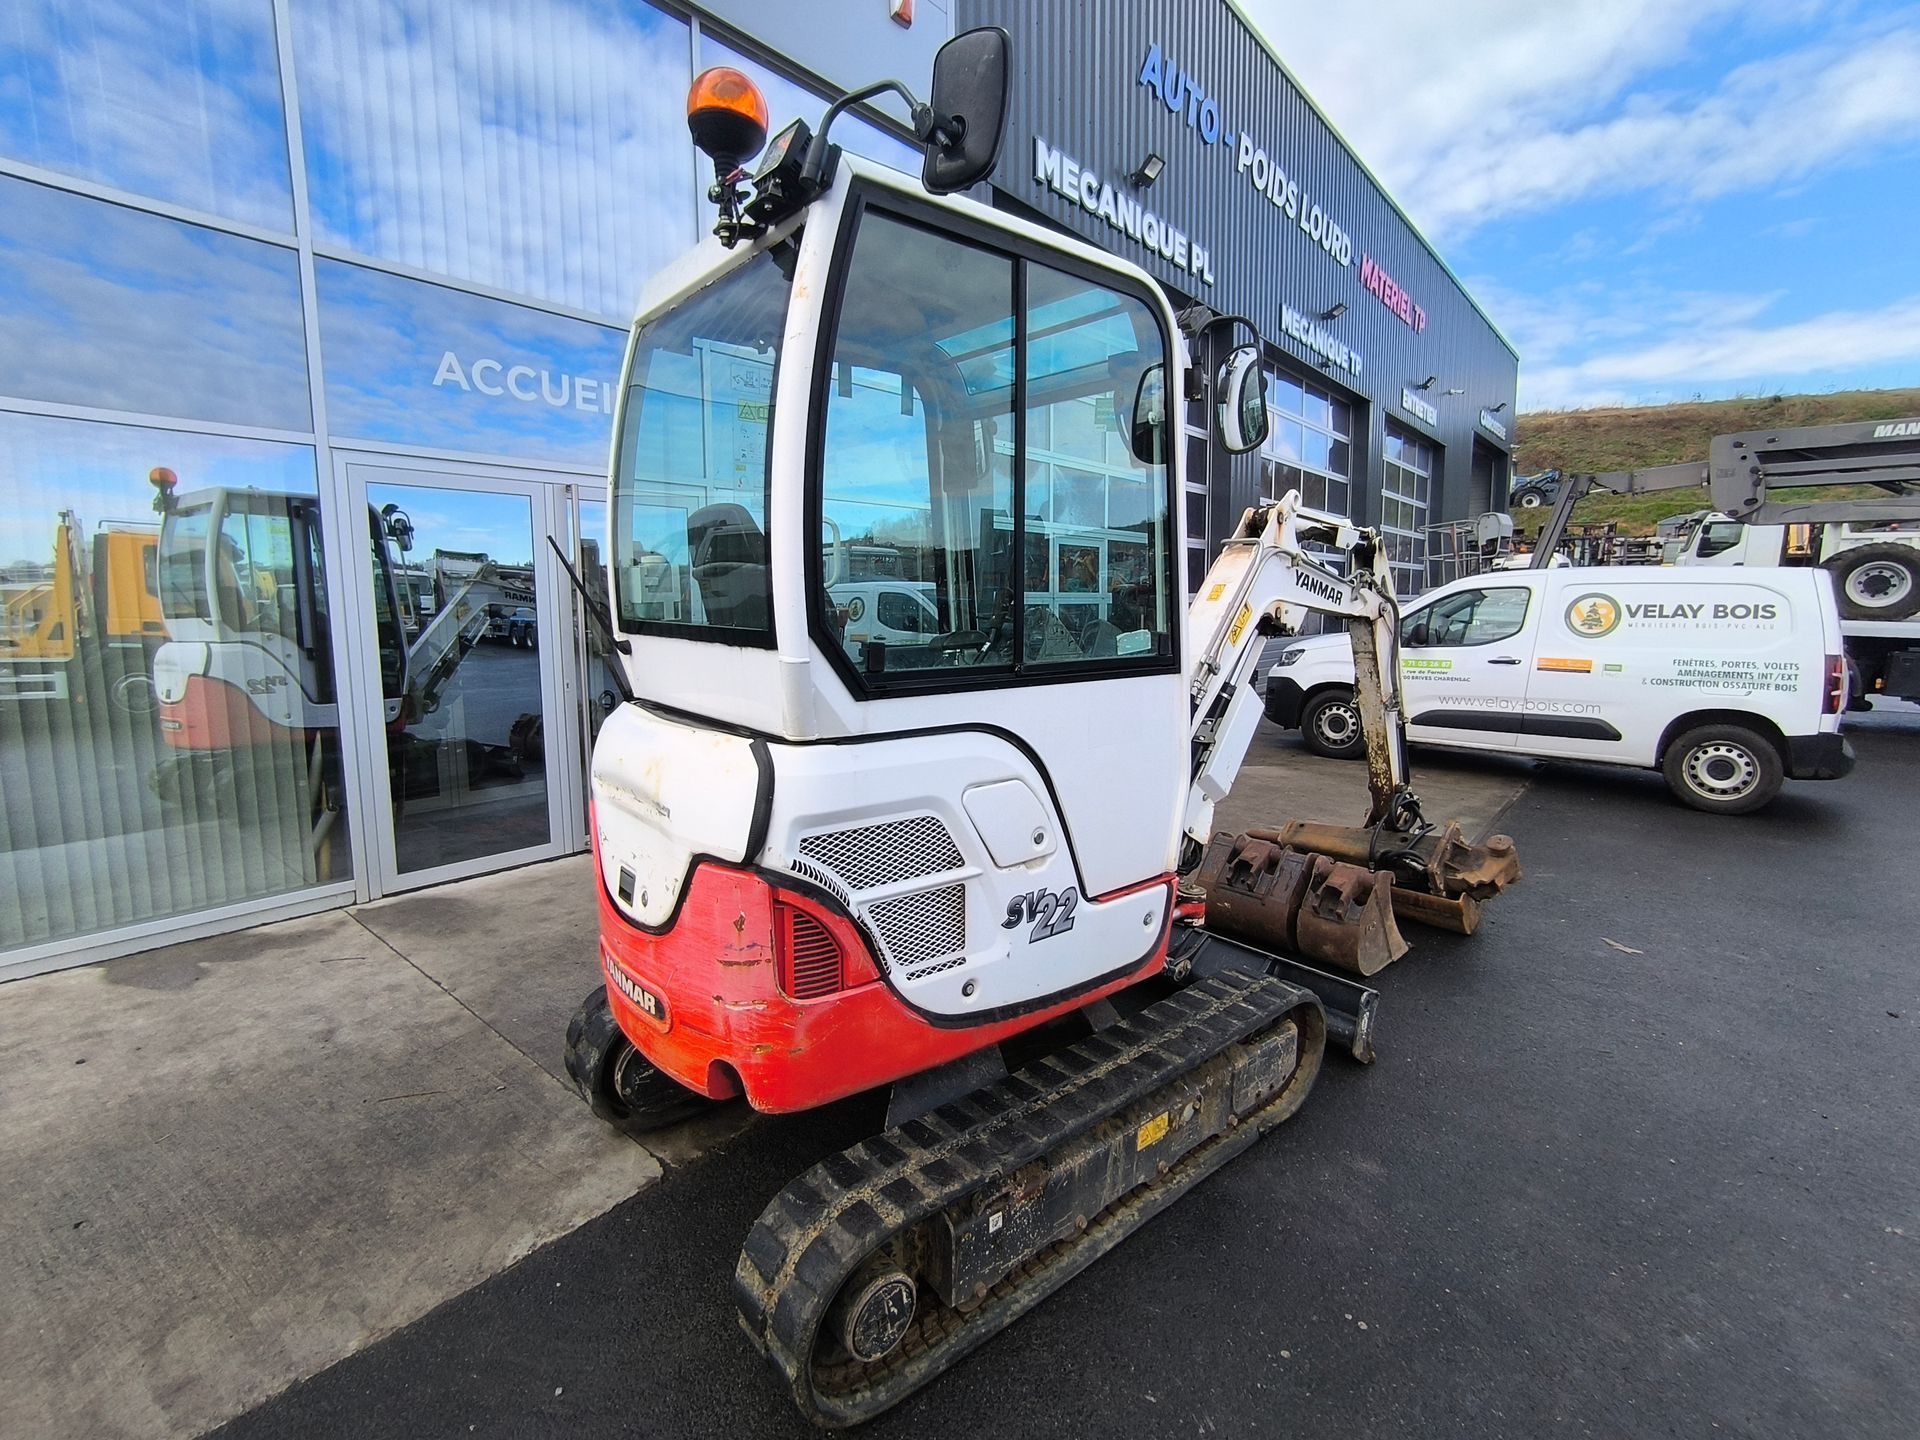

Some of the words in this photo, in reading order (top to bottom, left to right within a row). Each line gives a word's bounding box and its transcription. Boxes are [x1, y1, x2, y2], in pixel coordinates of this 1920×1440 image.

[1139, 43, 1220, 144] AUTO
[1236, 131, 1298, 219] POIDS
[1299, 192, 1351, 267] LOURD
[1359, 252, 1413, 327] MATERIEL
[1411, 302, 1426, 335] TP
[1033, 135, 1188, 270] MECANIQUE
[1189, 241, 1215, 287] PL
[1280, 302, 1350, 371] MECANIQUE
[1349, 348, 1363, 377] TP
[432, 351, 621, 415] ACCUEI
[1295, 568, 1343, 606] YANMAR
[1625, 603, 1705, 619] VELAY
[1712, 603, 1777, 620] BOIS
[1672, 658, 1718, 668] FENÊTRES,
[1721, 661, 1760, 670] PORTES,
[1764, 662, 1800, 671] VOLETS
[1677, 668, 1754, 680] AMÉNAGEMENTS
[1438, 694, 1602, 714] www.velay-bois.com
[1650, 678, 1720, 688] CONSTRUCTION
[1722, 681, 1772, 691] OSSATURE
[1774, 684, 1798, 693] BOIS
[1000, 886, 1079, 944] SV22
